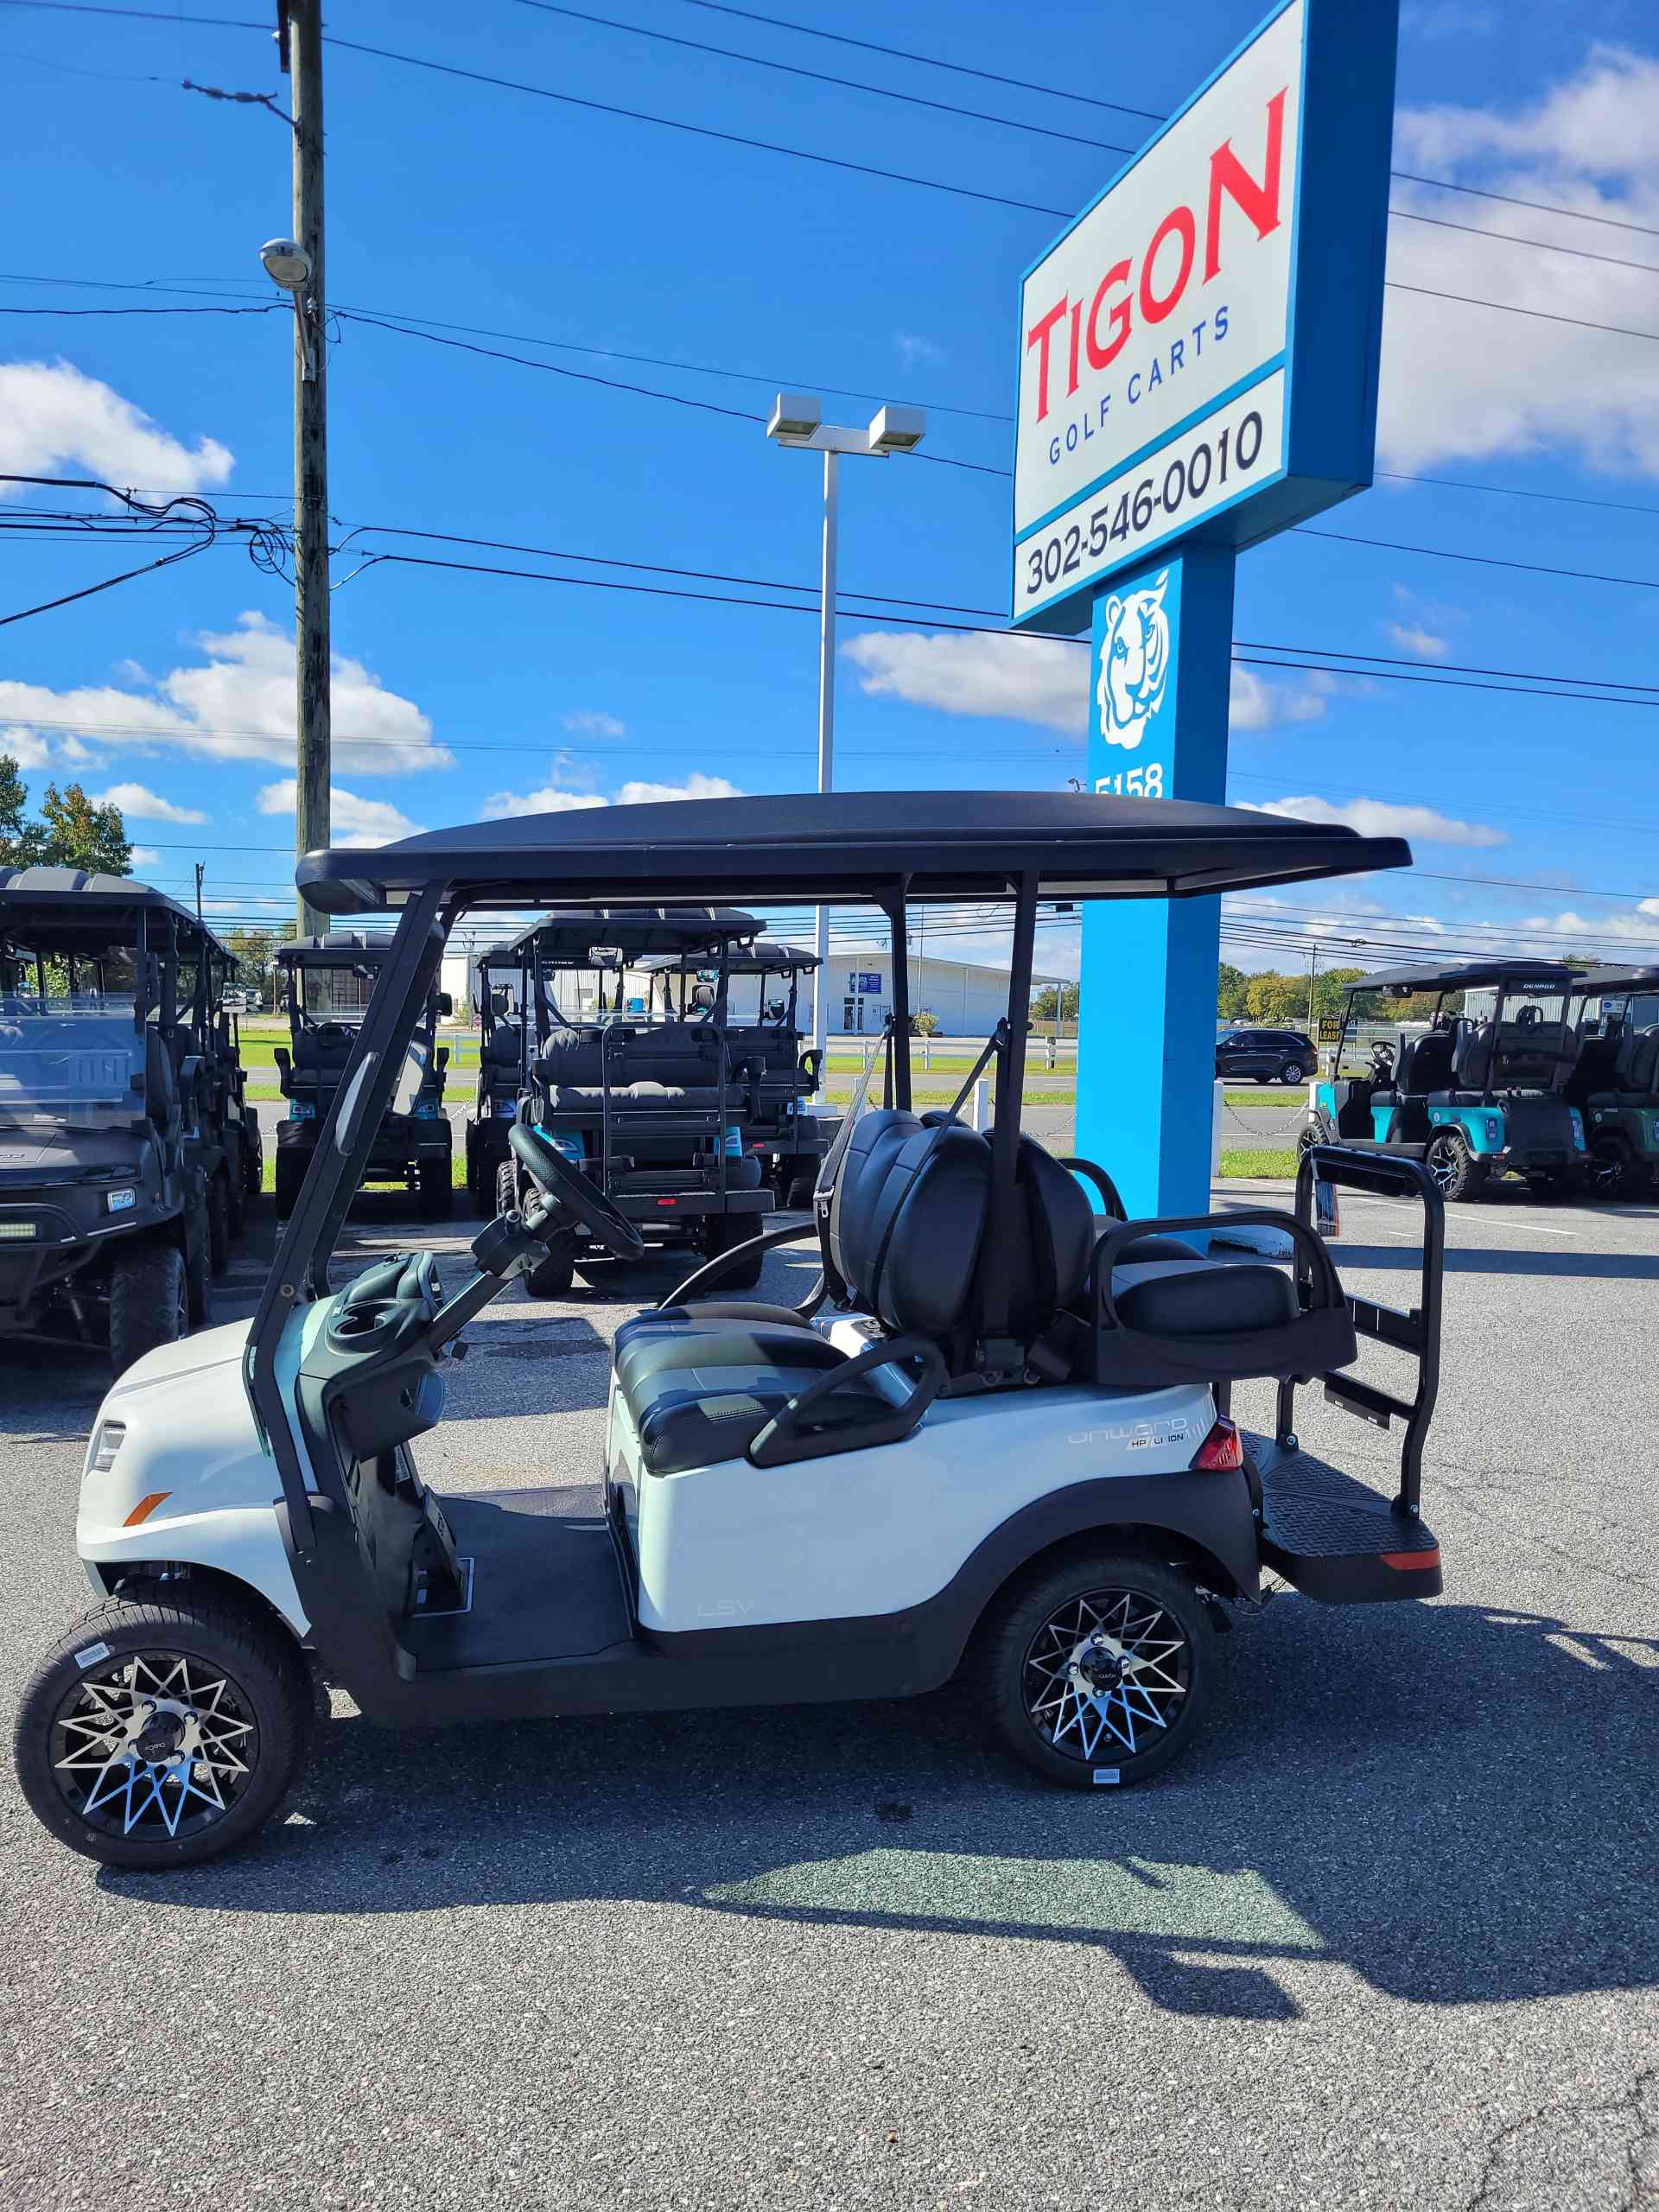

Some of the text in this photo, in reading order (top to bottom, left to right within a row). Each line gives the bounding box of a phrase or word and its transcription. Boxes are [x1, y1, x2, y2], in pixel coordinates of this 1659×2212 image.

[1027, 86, 1288, 423] TIGON
[1048, 304, 1230, 465] GOLF CARTS
[1027, 410, 1263, 594] 302-546-0010
[1132, 1440, 1147, 1448] HP
[1168, 1433, 1184, 1443] ION
[697, 1597, 754, 1618] LSV
